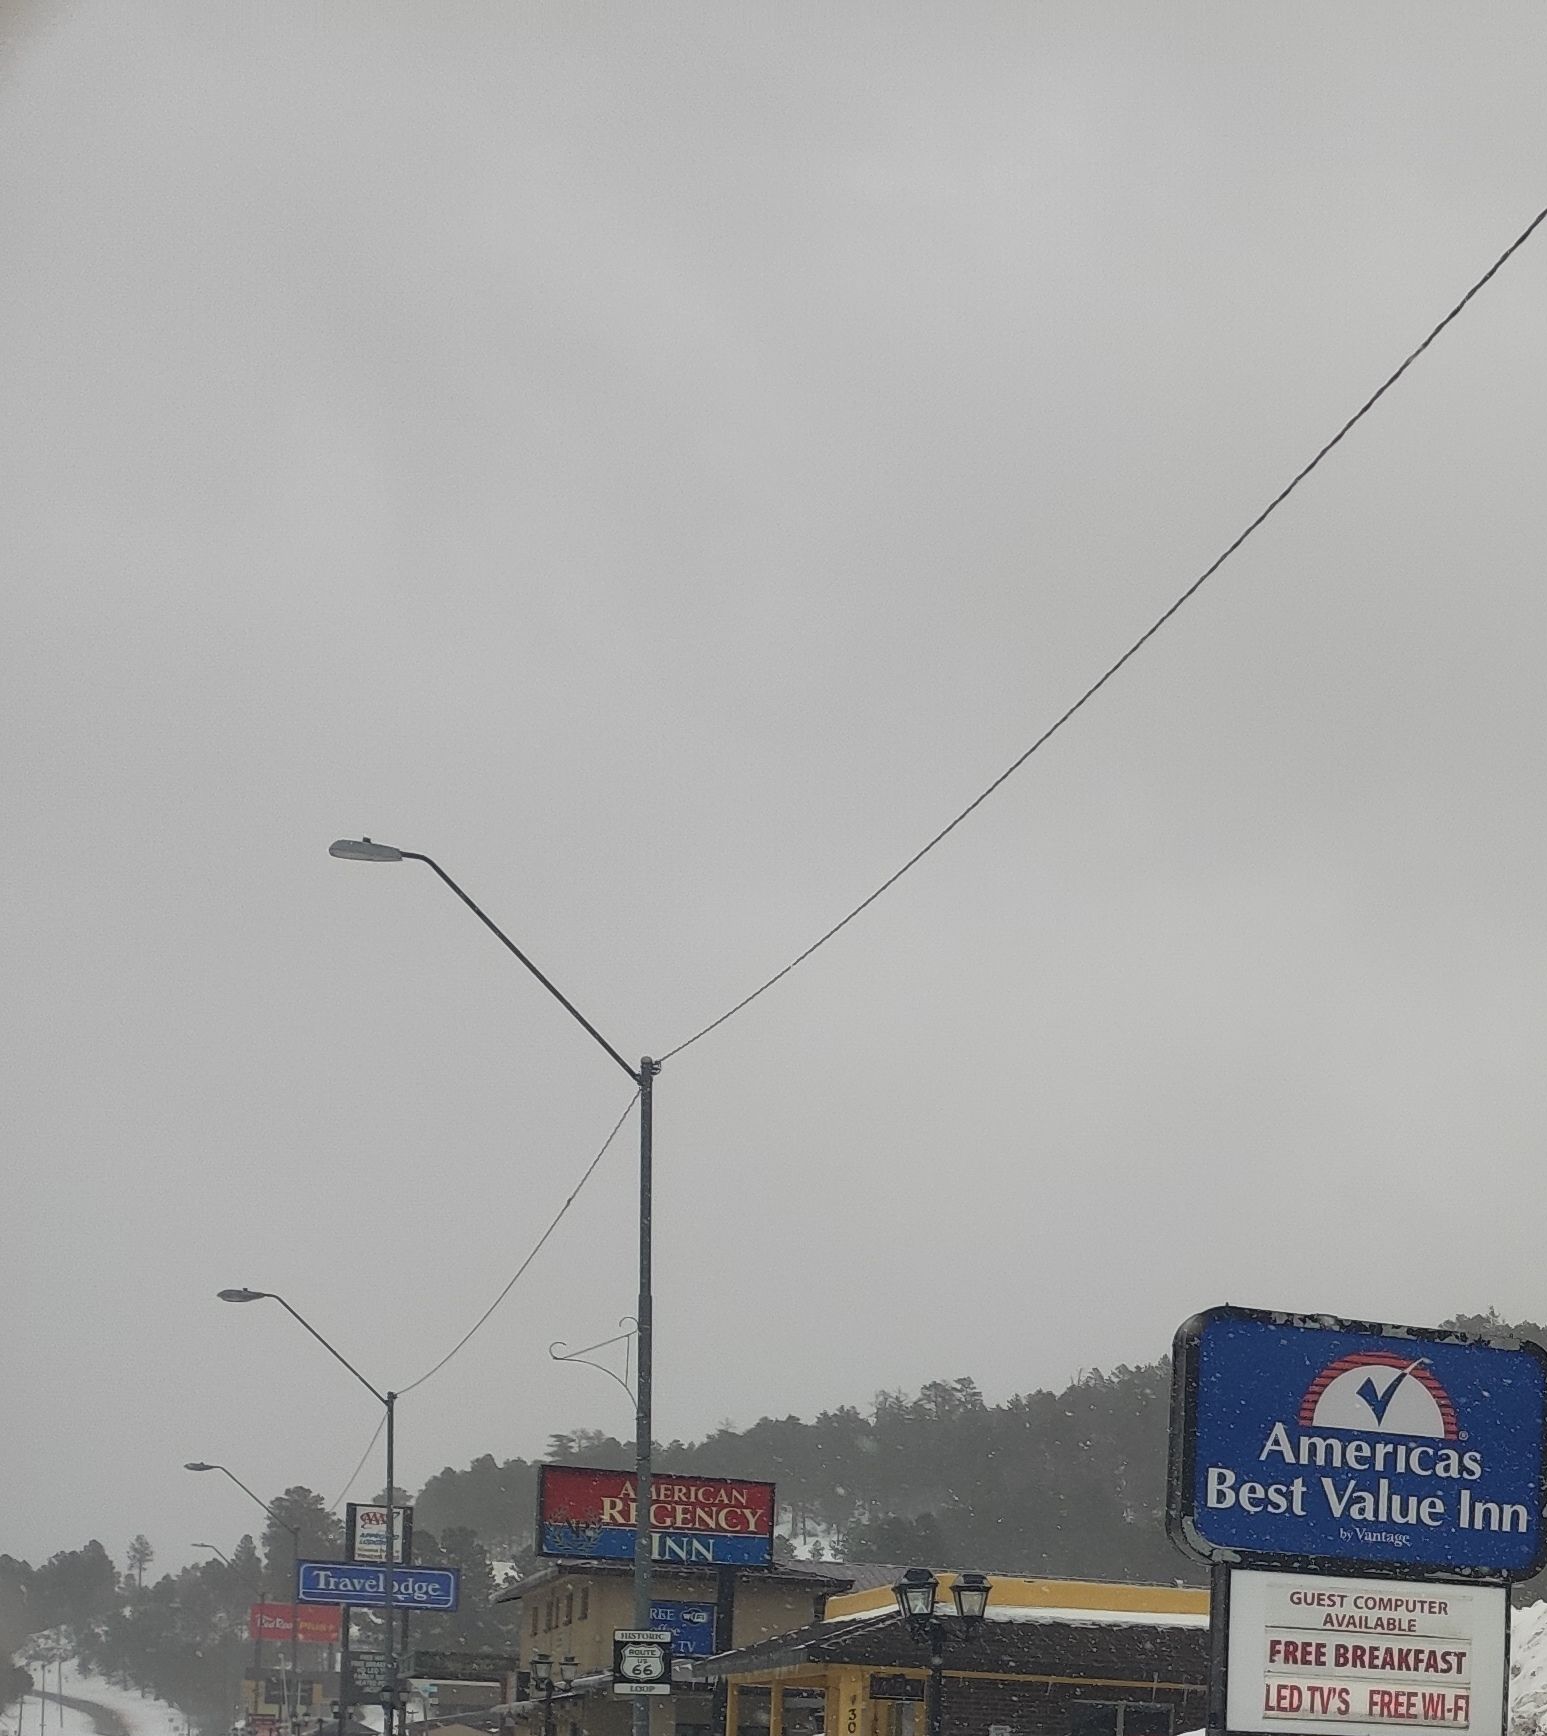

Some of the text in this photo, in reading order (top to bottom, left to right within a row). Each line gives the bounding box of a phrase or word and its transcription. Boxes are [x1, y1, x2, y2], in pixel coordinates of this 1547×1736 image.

[1258, 1421, 1482, 1480] Americas
[1207, 1467, 1528, 1533] Best Value Inn
[651, 1533, 715, 1561] INN
[1340, 1528, 1411, 1547] by Vantage
[649, 1607, 676, 1620] REE
[1290, 1591, 1449, 1615] GUEST COMPUTER
[1322, 1612, 1417, 1632] AVAILABLE
[620, 1632, 664, 1641] HISTORIC
[1269, 1639, 1466, 1675] FREE BREAKFAST
[632, 1664, 653, 1676] 66
[1264, 1683, 1470, 1722] LED TV'S FREE WI-FI
